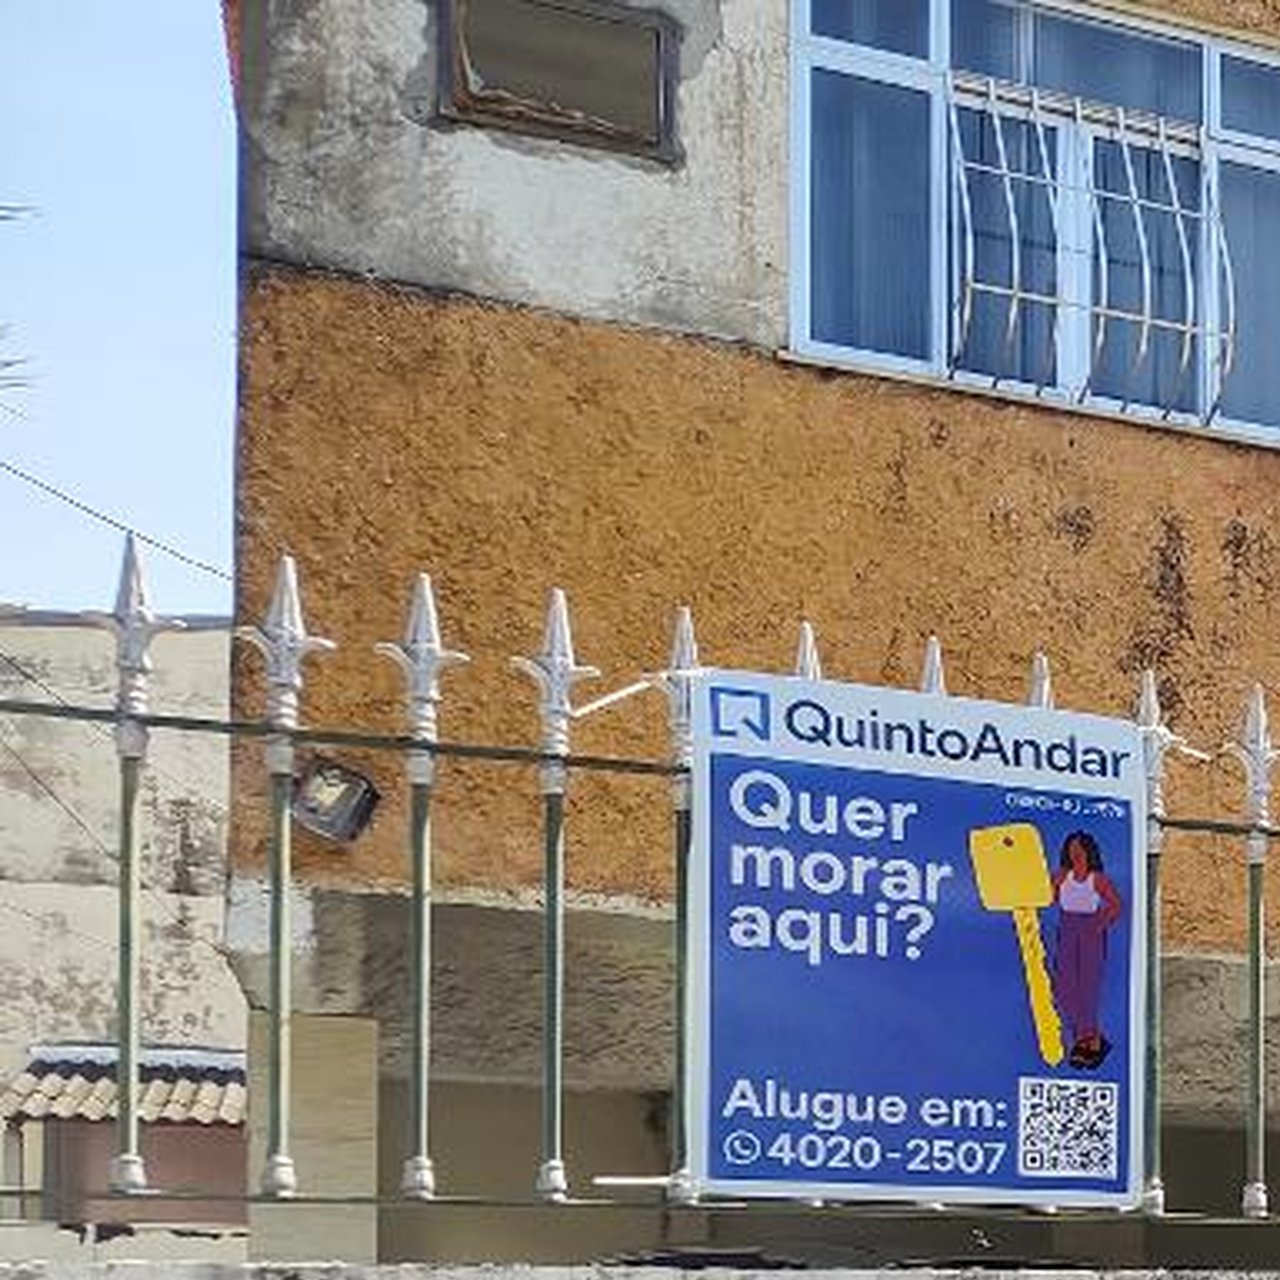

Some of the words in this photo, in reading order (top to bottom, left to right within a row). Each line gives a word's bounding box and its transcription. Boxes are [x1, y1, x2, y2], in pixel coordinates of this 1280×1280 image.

[784, 699, 1131, 779] QuintoAndar
[729, 769, 918, 842] Quer
[730, 843, 953, 904] morar
[729, 902, 935, 966] aqui?
[722, 1078, 907, 1132] Alugue
[920, 1096, 1008, 1129] em:
[766, 1132, 1008, 1175] 4020-2507
